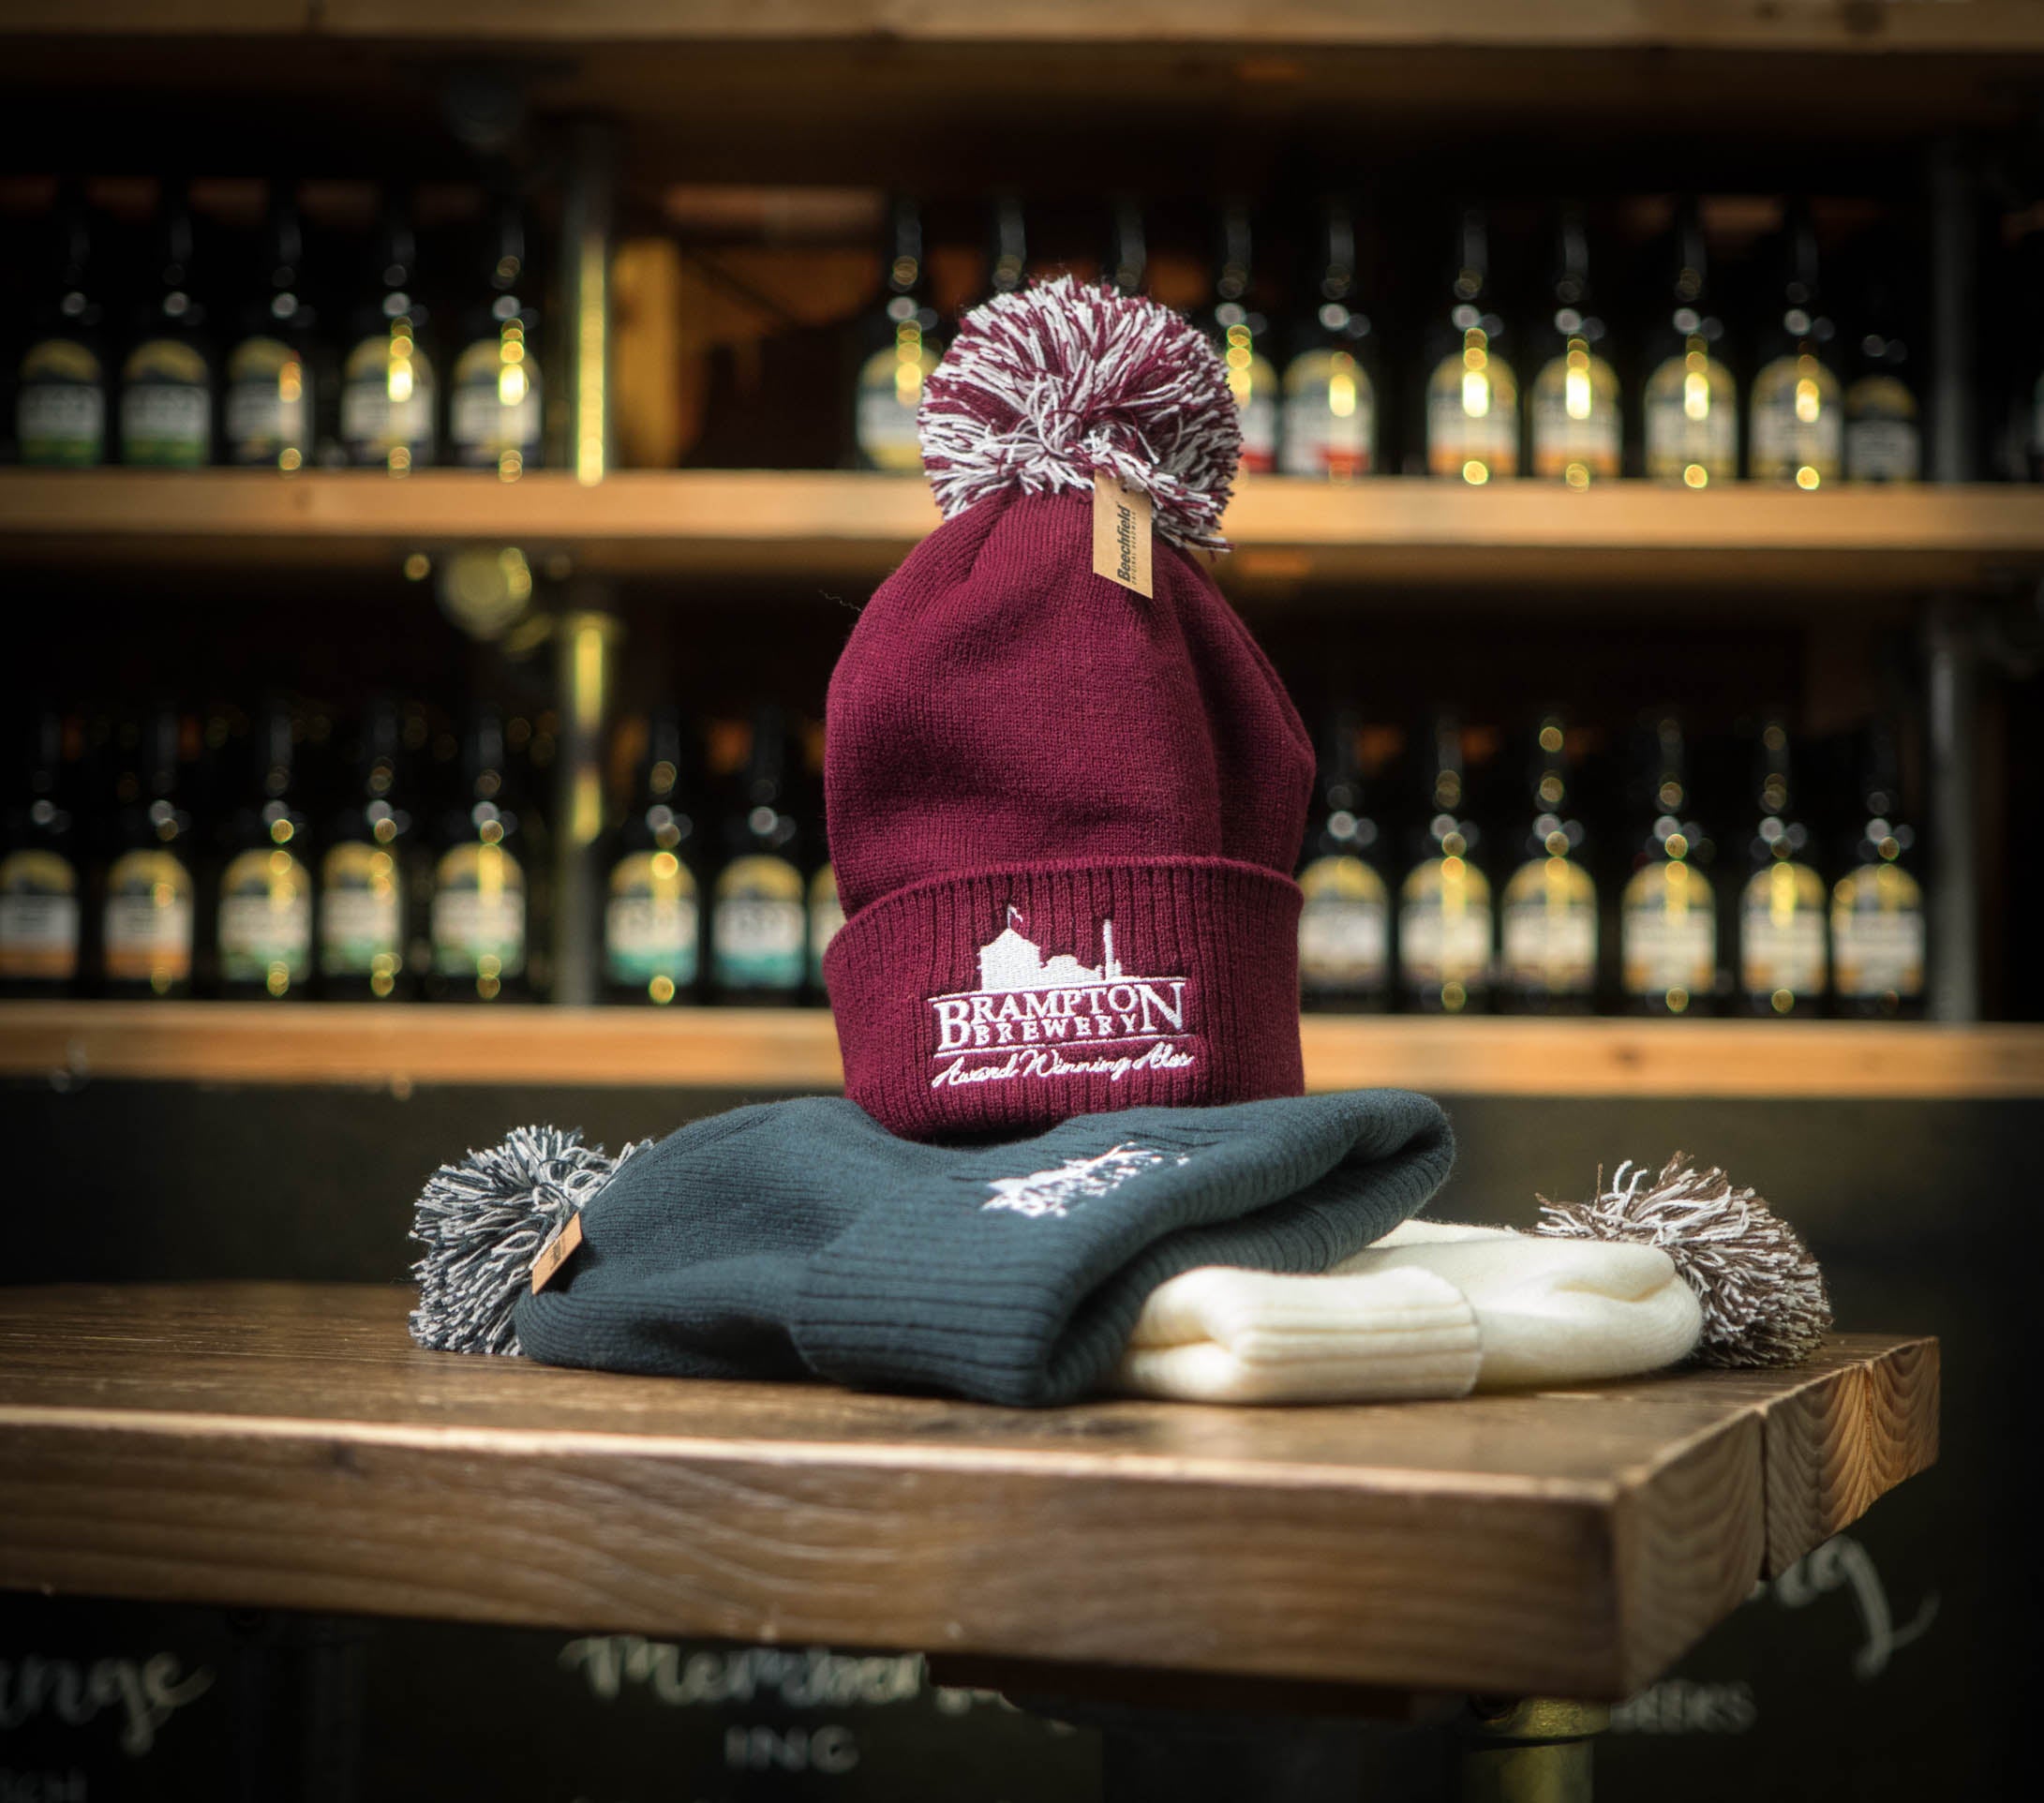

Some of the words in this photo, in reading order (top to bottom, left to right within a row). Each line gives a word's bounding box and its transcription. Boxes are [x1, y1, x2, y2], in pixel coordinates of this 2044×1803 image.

[1117, 503, 1131, 583] Beechfield
[932, 981, 1186, 1051] BRAMPTON
[973, 1013, 1137, 1047] BREWERY
[932, 1055, 1019, 1088] Award
[1019, 1048, 1132, 1081] Winning
[1131, 1041, 1195, 1070] Ales
